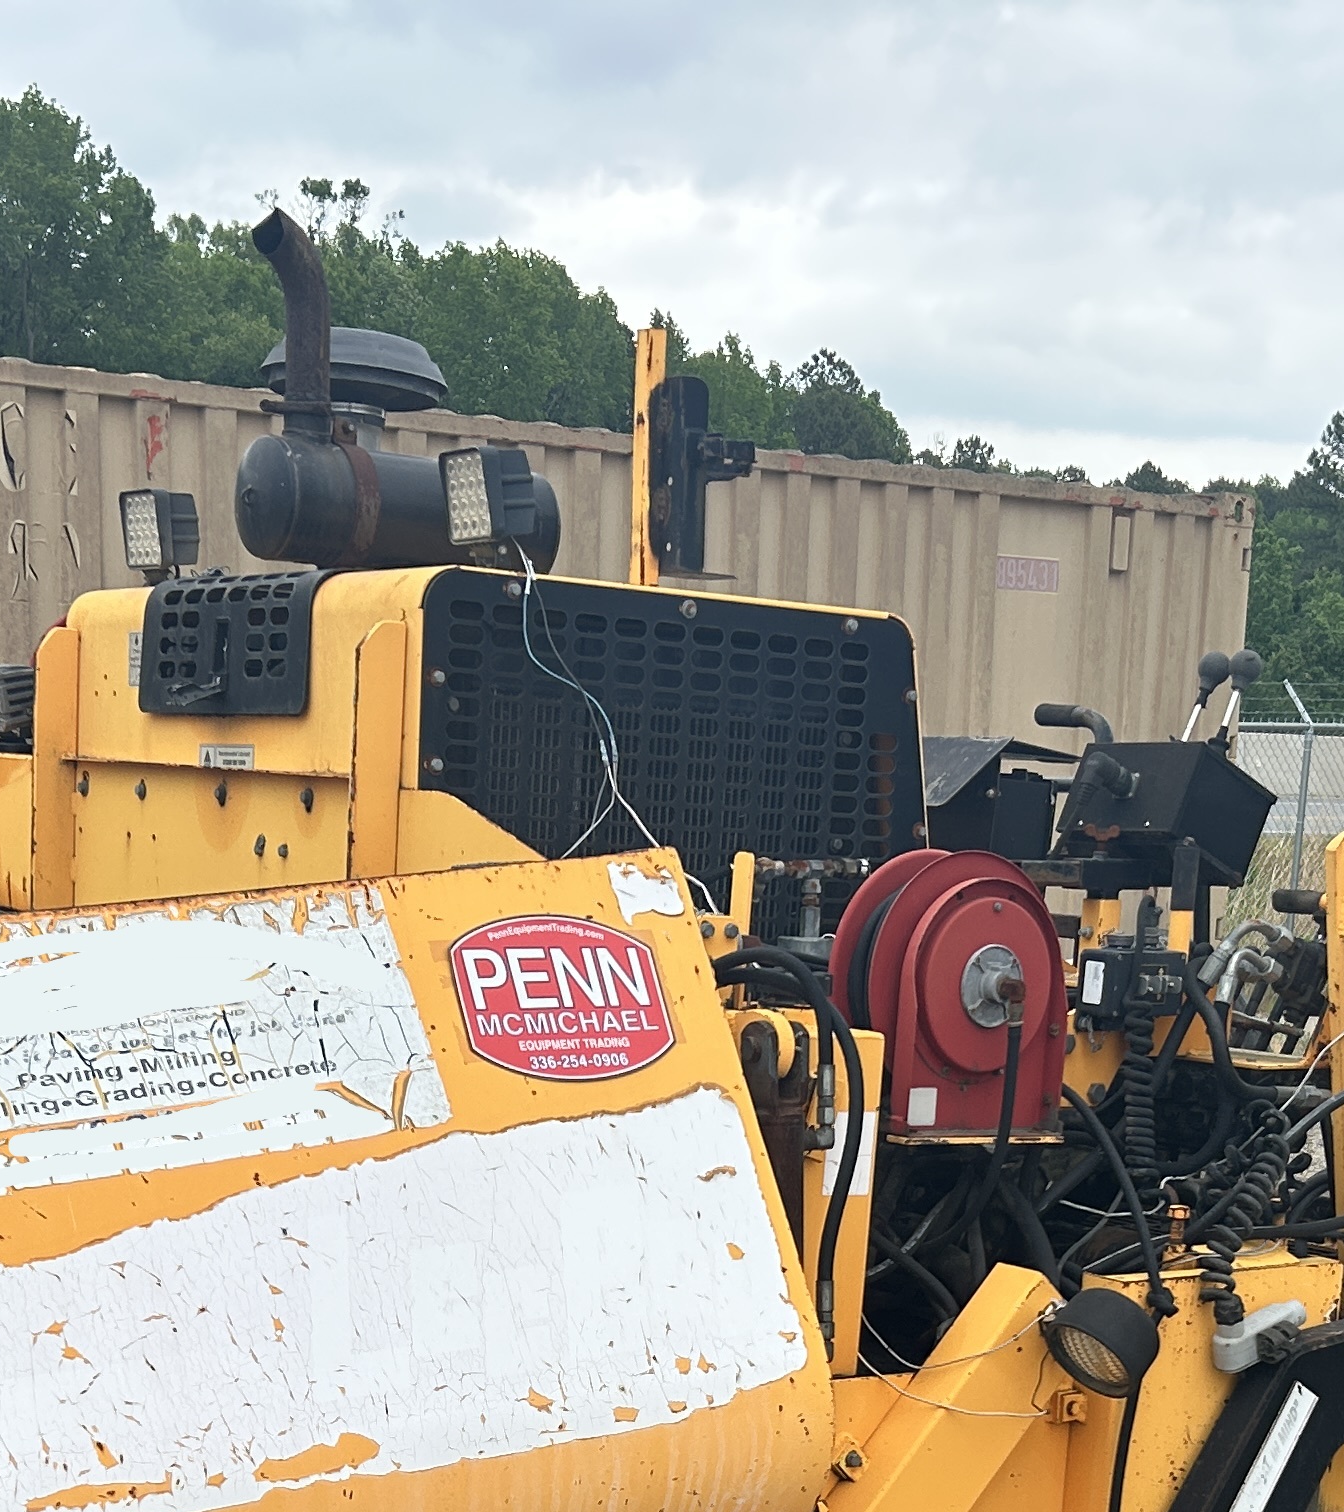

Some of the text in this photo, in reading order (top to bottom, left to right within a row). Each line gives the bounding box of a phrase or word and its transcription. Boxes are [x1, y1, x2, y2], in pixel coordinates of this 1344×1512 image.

[462, 947, 652, 1010] PENN
[476, 1010, 659, 1036] MCMICHAEL
[518, 1036, 631, 1052] EQUIPMENT TRADING
[530, 1053, 629, 1070] 336-254-0906
[18, 1065, 123, 1087] Paving
[76, 1077, 195, 1107] Grading
[209, 1060, 338, 1088] Concrete
